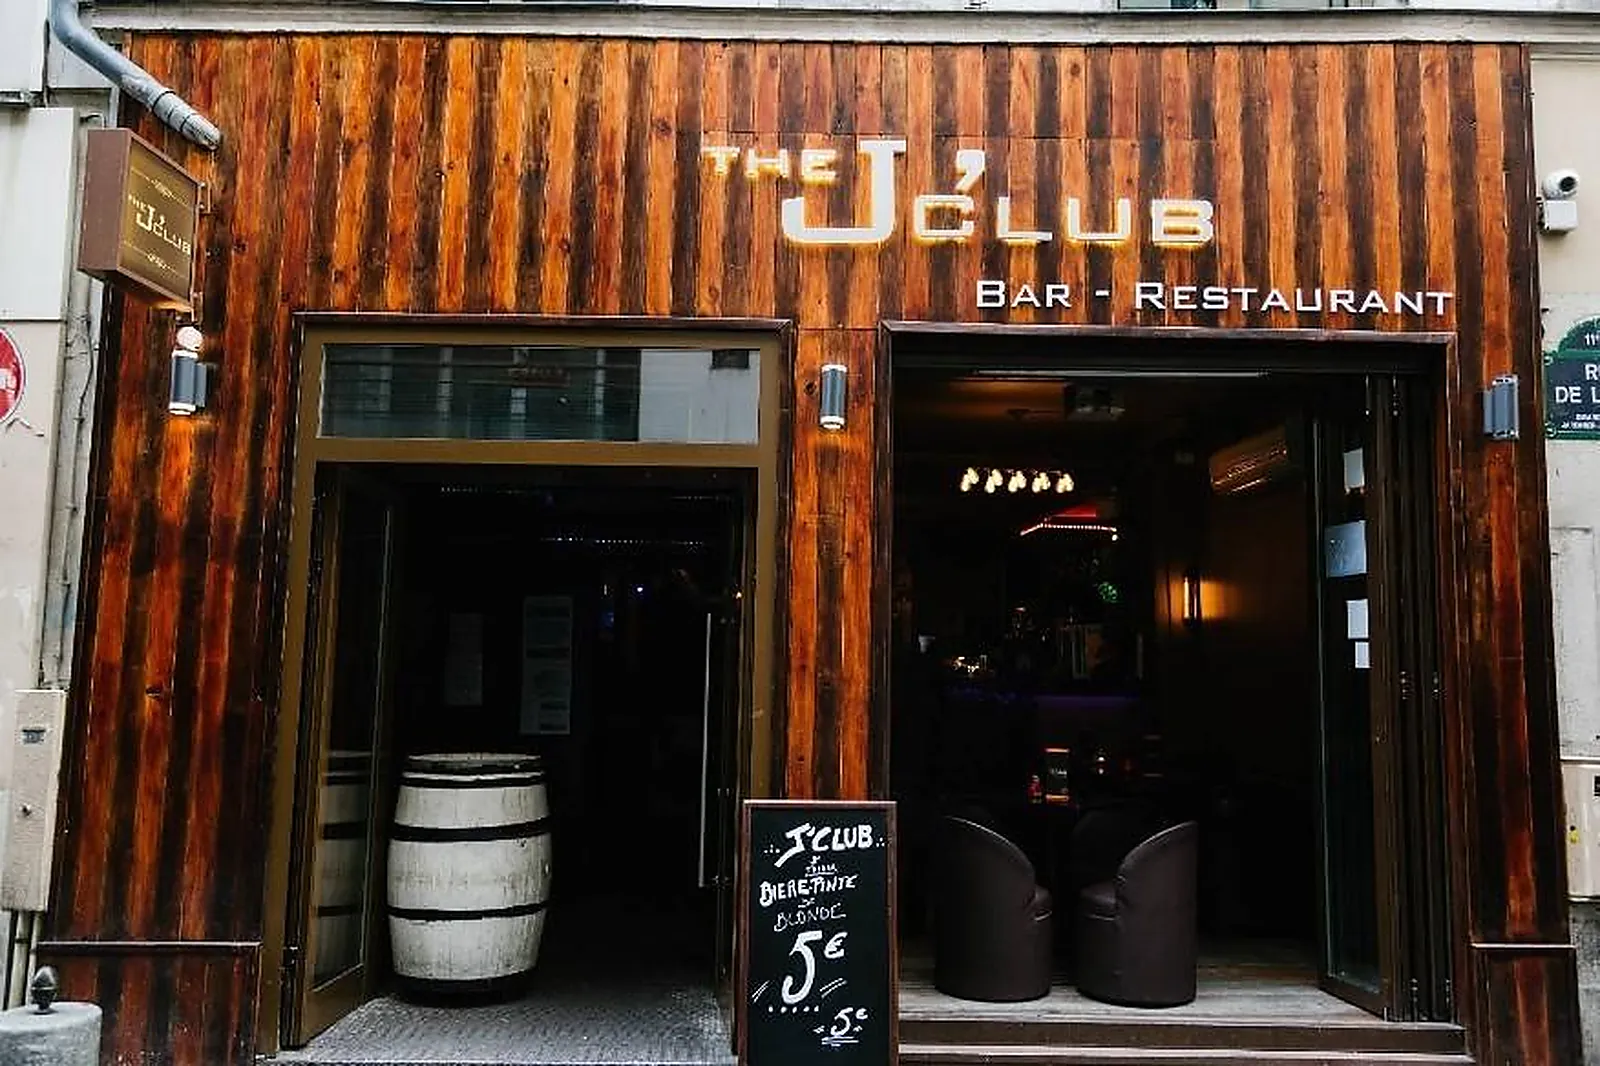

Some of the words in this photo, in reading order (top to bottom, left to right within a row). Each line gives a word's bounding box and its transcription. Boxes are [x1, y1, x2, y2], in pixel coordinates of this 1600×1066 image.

[701, 146, 837, 181] THE
[1555, 386, 1582, 403] DE
[773, 902, 847, 932] BLONDE
